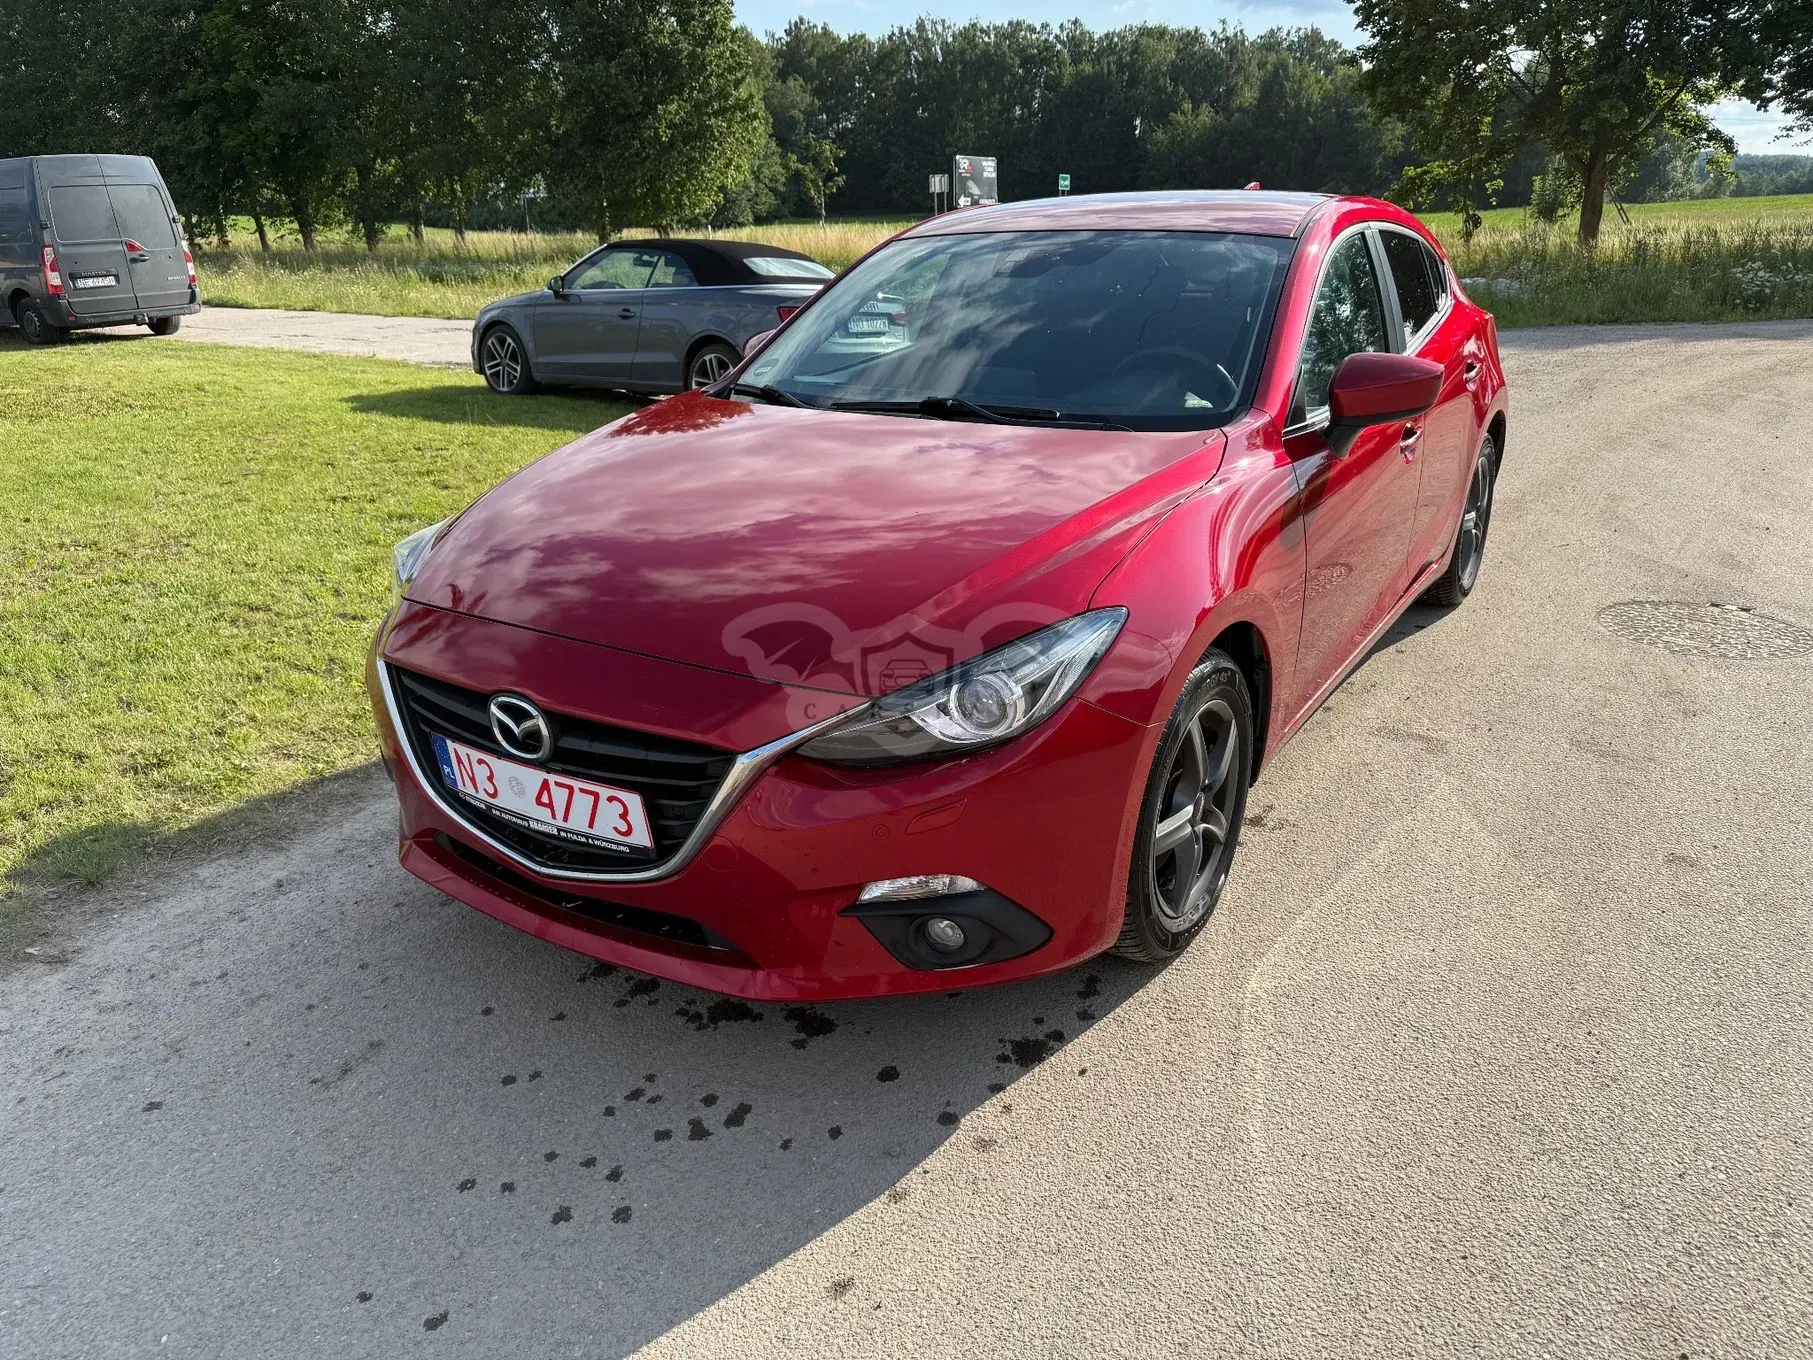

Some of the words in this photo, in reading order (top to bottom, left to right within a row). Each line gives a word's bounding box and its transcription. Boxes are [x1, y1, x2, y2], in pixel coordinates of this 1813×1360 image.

[442, 764, 456, 779] PL
[453, 747, 499, 800] N3
[534, 777, 634, 838] 4773
[567, 833, 587, 843] FULDA
